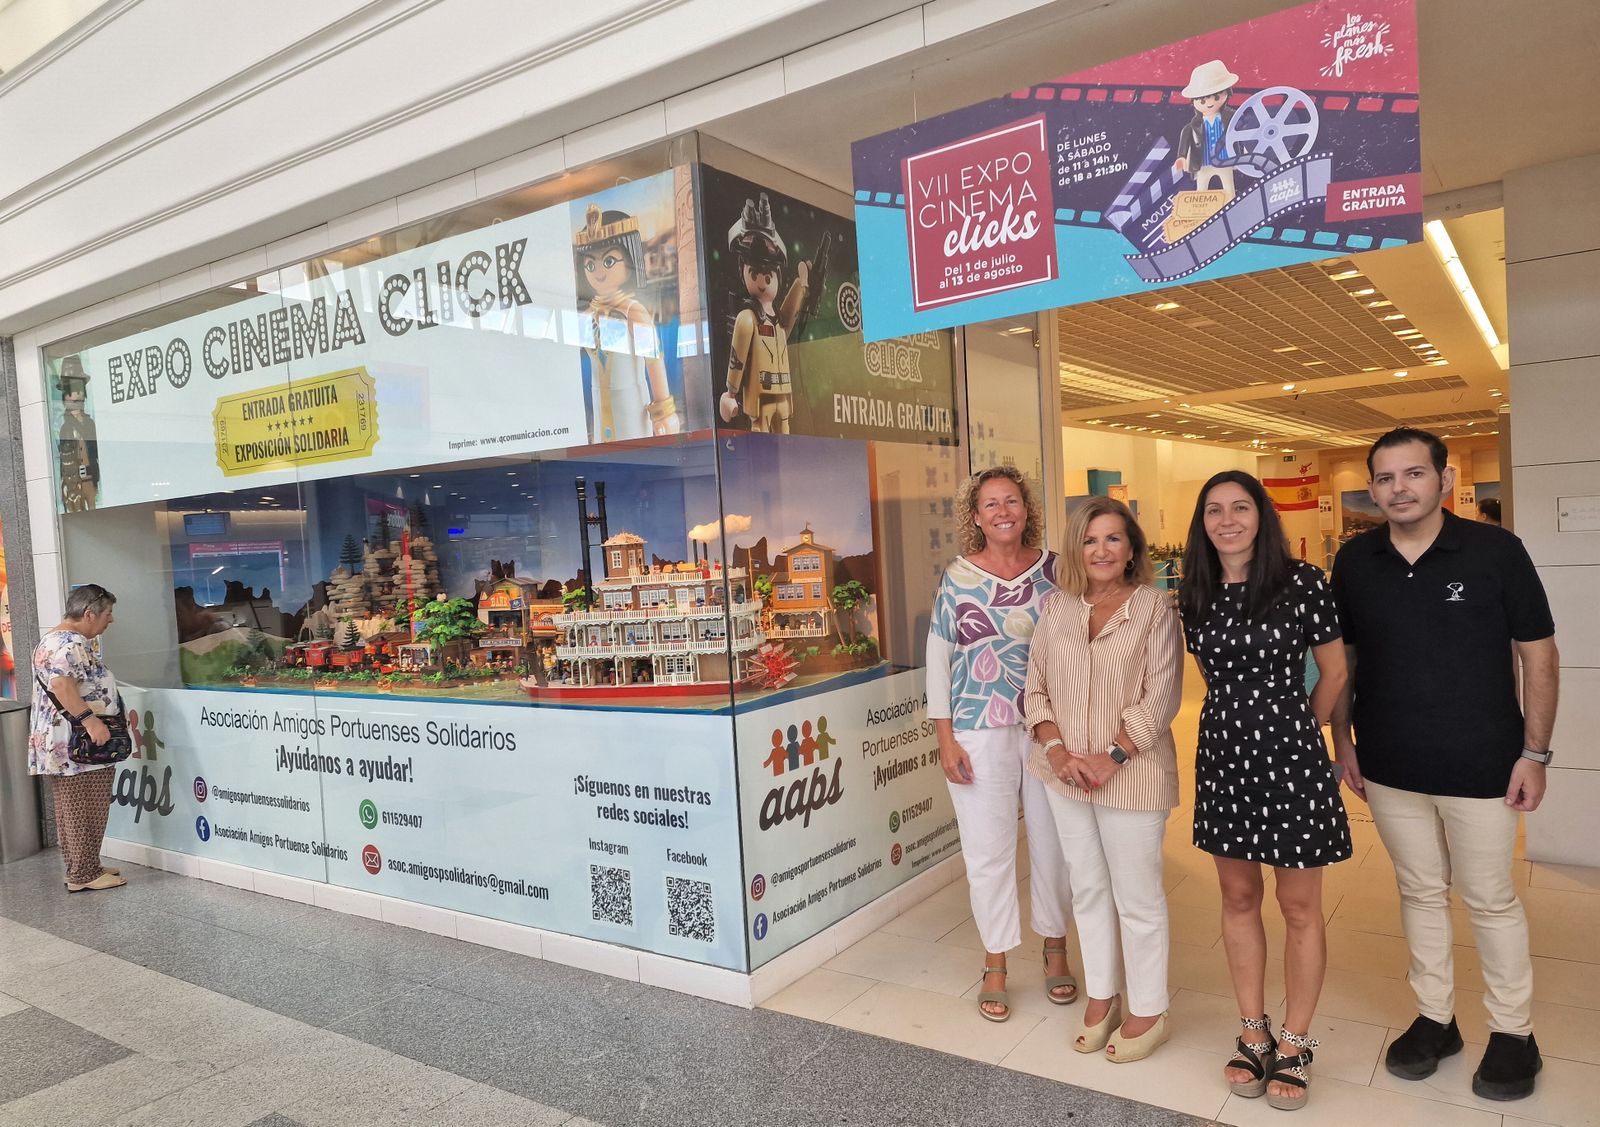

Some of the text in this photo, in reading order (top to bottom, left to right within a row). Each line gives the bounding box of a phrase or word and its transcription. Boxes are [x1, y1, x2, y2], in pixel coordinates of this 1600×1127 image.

[1333, 22, 1377, 48] planes
[1346, 12, 1362, 28] Los
[1056, 131, 1107, 152] DE LUNES
[1057, 154, 1065, 163] A
[1058, 165, 1070, 175] de
[1072, 161, 1081, 171] 11
[1092, 154, 1110, 166] 14h
[1113, 153, 1119, 162] y
[1058, 177, 1071, 186] de
[1073, 173, 1084, 183] 18
[1095, 162, 1128, 178] 21:30h
[918, 151, 1032, 200] VII EXPO
[918, 179, 1038, 229] CINEMA
[1184, 195, 1218, 203] CINEMA
[1342, 195, 1406, 212] GRATUITA
[1343, 183, 1405, 200] ENTRADA
[943, 204, 1041, 258] clicks
[939, 263, 1024, 289] al 13 de agosto
[944, 254, 1016, 277] Del 1 de julio
[108, 237, 534, 404] EXPO CINEMA CLICK
[864, 341, 922, 382] CLICK
[242, 384, 338, 421] ENTRADA GRATUITA
[357, 392, 367, 431] 231769
[833, 393, 953, 434] ENTRADA GRATUITA
[235, 426, 349, 463] EXPOSICIÓN SOLIDARIA
[448, 426, 569, 451] Imprime: www.qcomunicacion.com
[866, 696, 919, 727] Asociación
[200, 706, 516, 751] Asociación Amigos Portuenses Solidarios
[862, 728, 919, 760] Portuenses
[275, 744, 414, 784] ¡Ayúdanos a ayudar!
[873, 756, 919, 791] ¡Ayúdanos
[921, 753, 927, 767] a
[212, 785, 310, 812] @amigosportuensessolidarios
[573, 774, 711, 806] ¡Síguenos en nuestras
[759, 756, 844, 832] aaps
[382, 809, 423, 829] 611529407
[597, 802, 689, 830] redes sociales!
[901, 797, 933, 824] 611529407
[214, 823, 348, 861] Asociación Amigos Portuense Solidarios
[588, 837, 629, 856] Instagram
[666, 848, 708, 868] Facebook
[771, 837, 857, 887] @amigosportuensessolidarios
[387, 857, 550, 901] asoc.amigospsolidarios@gmail.com
[772, 858, 883, 925] Asociación Amigos Portuense Solidarios
